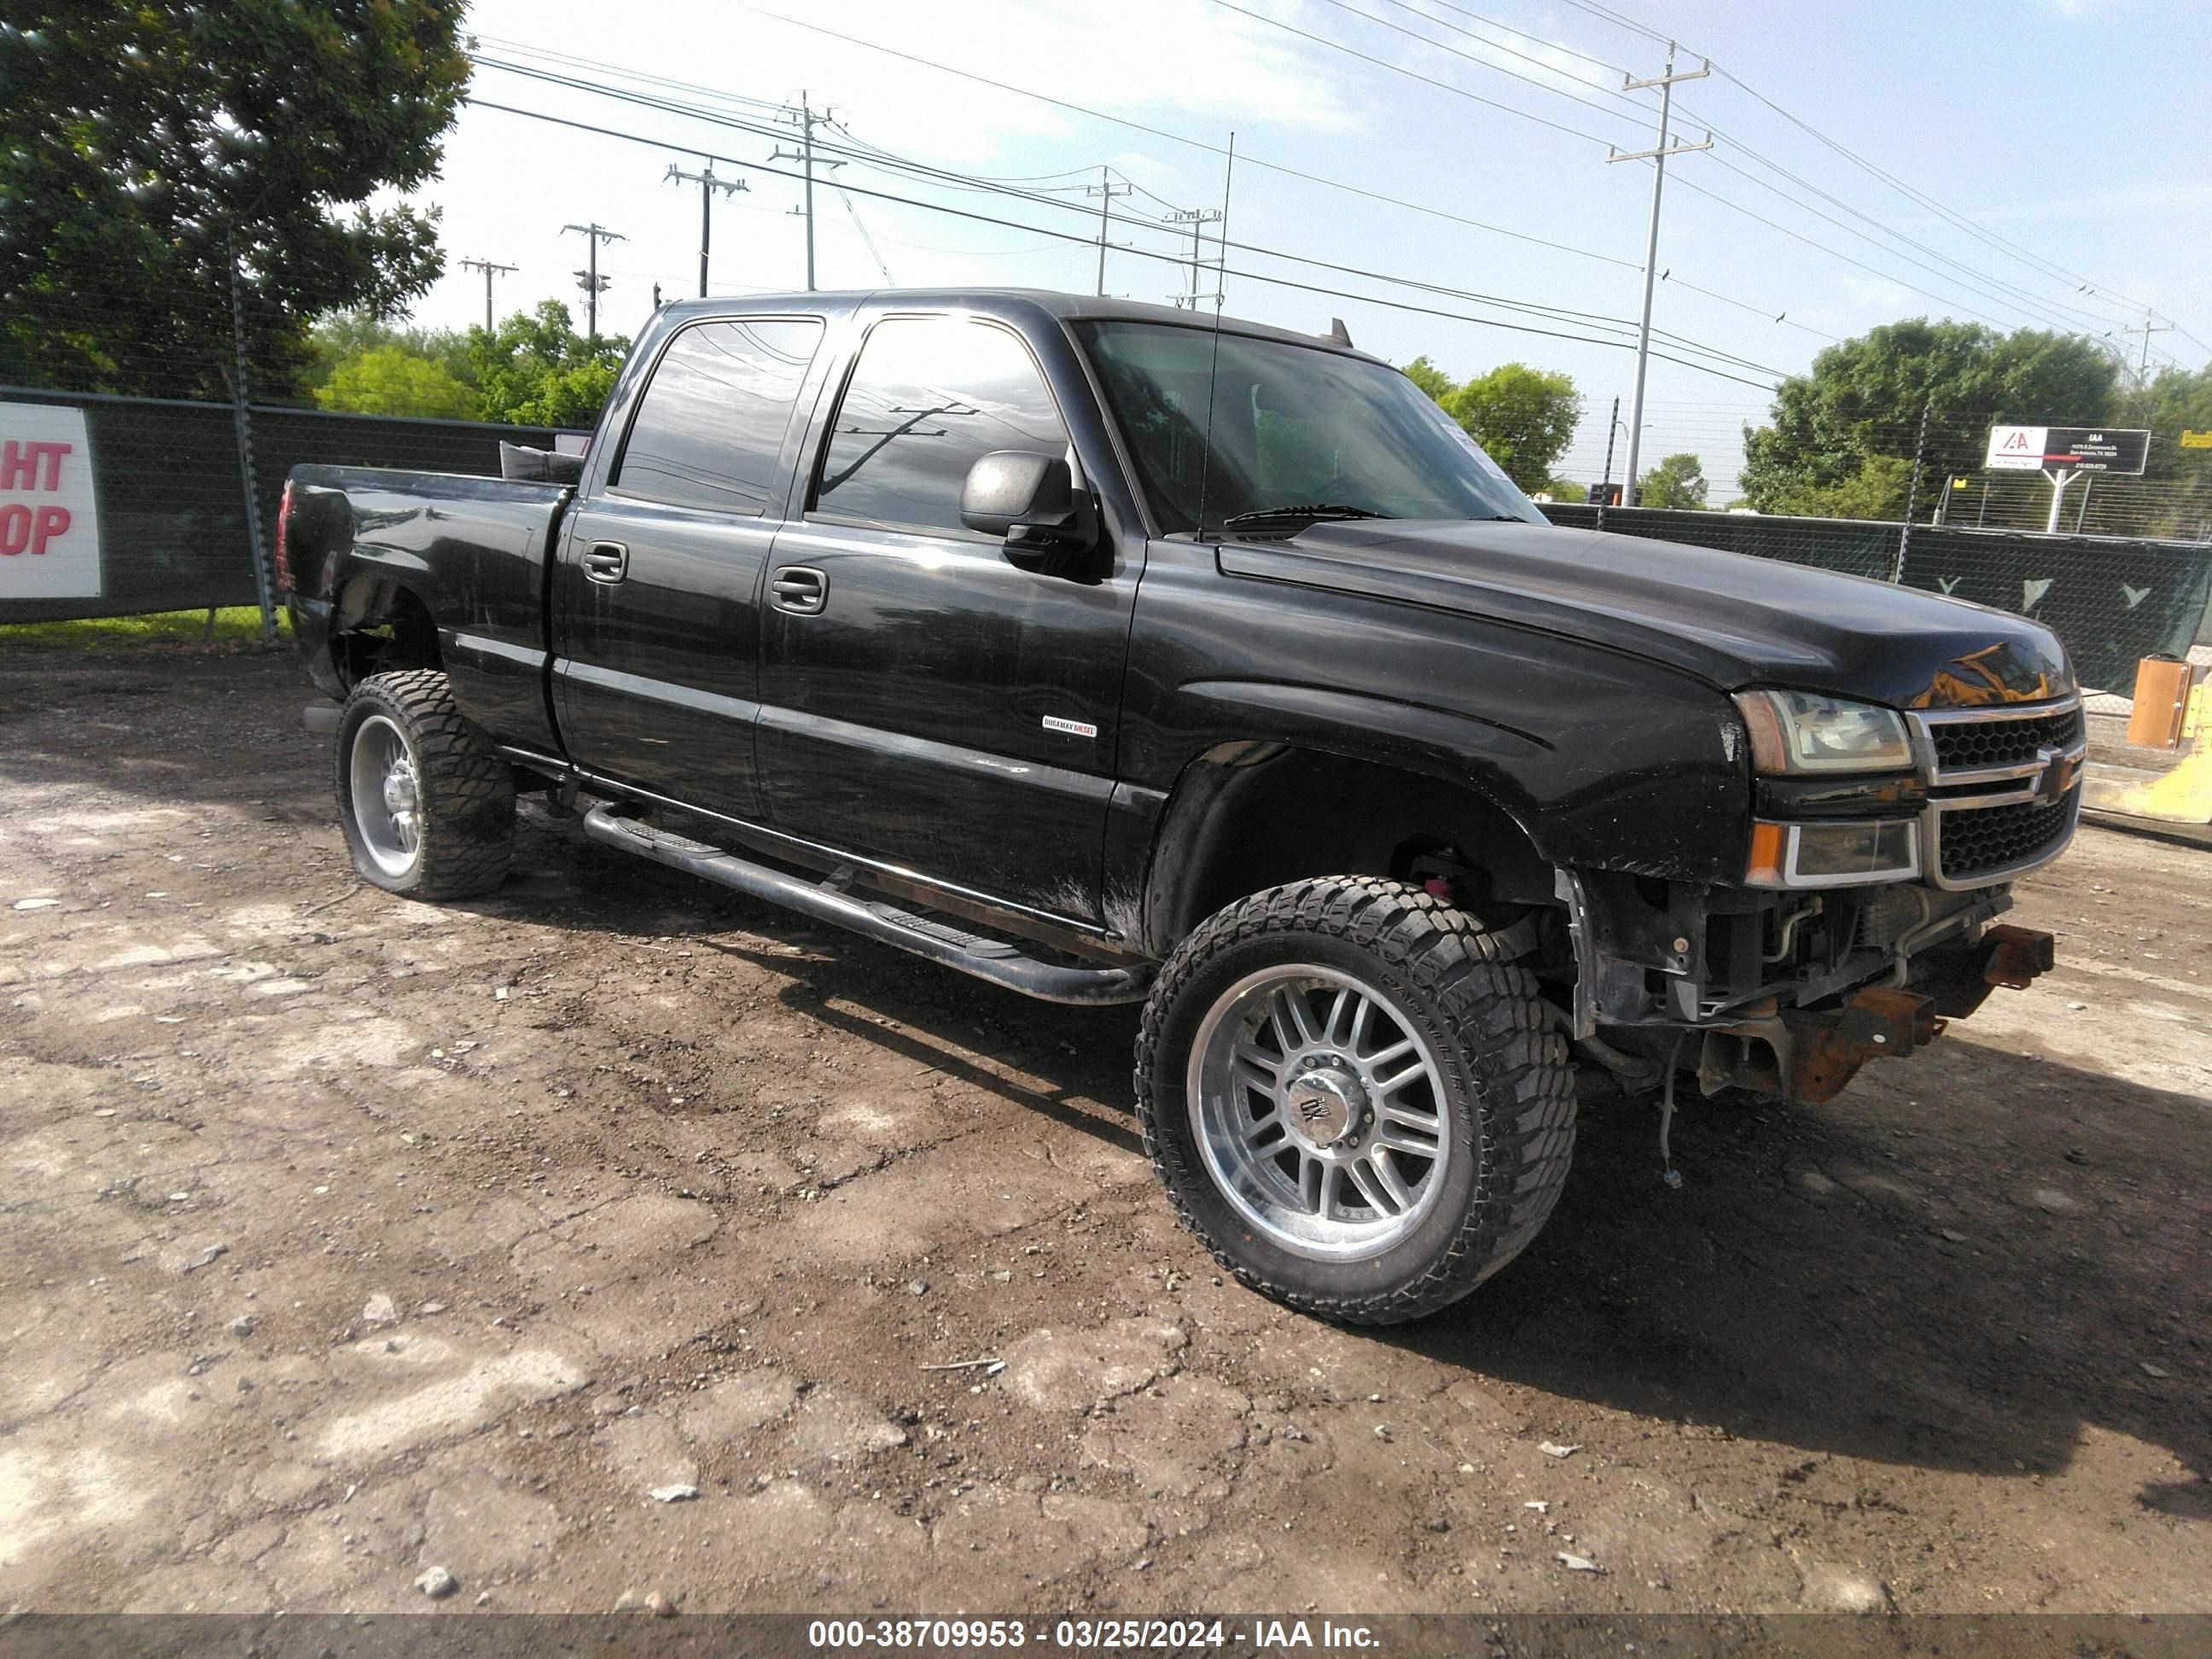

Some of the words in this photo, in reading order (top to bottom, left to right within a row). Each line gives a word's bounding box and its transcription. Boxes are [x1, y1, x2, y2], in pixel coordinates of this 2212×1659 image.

[2088, 434, 2103, 442] IAA
[1045, 719, 1073, 730] DURAMAX
[1074, 725, 1093, 734] DIESEL
